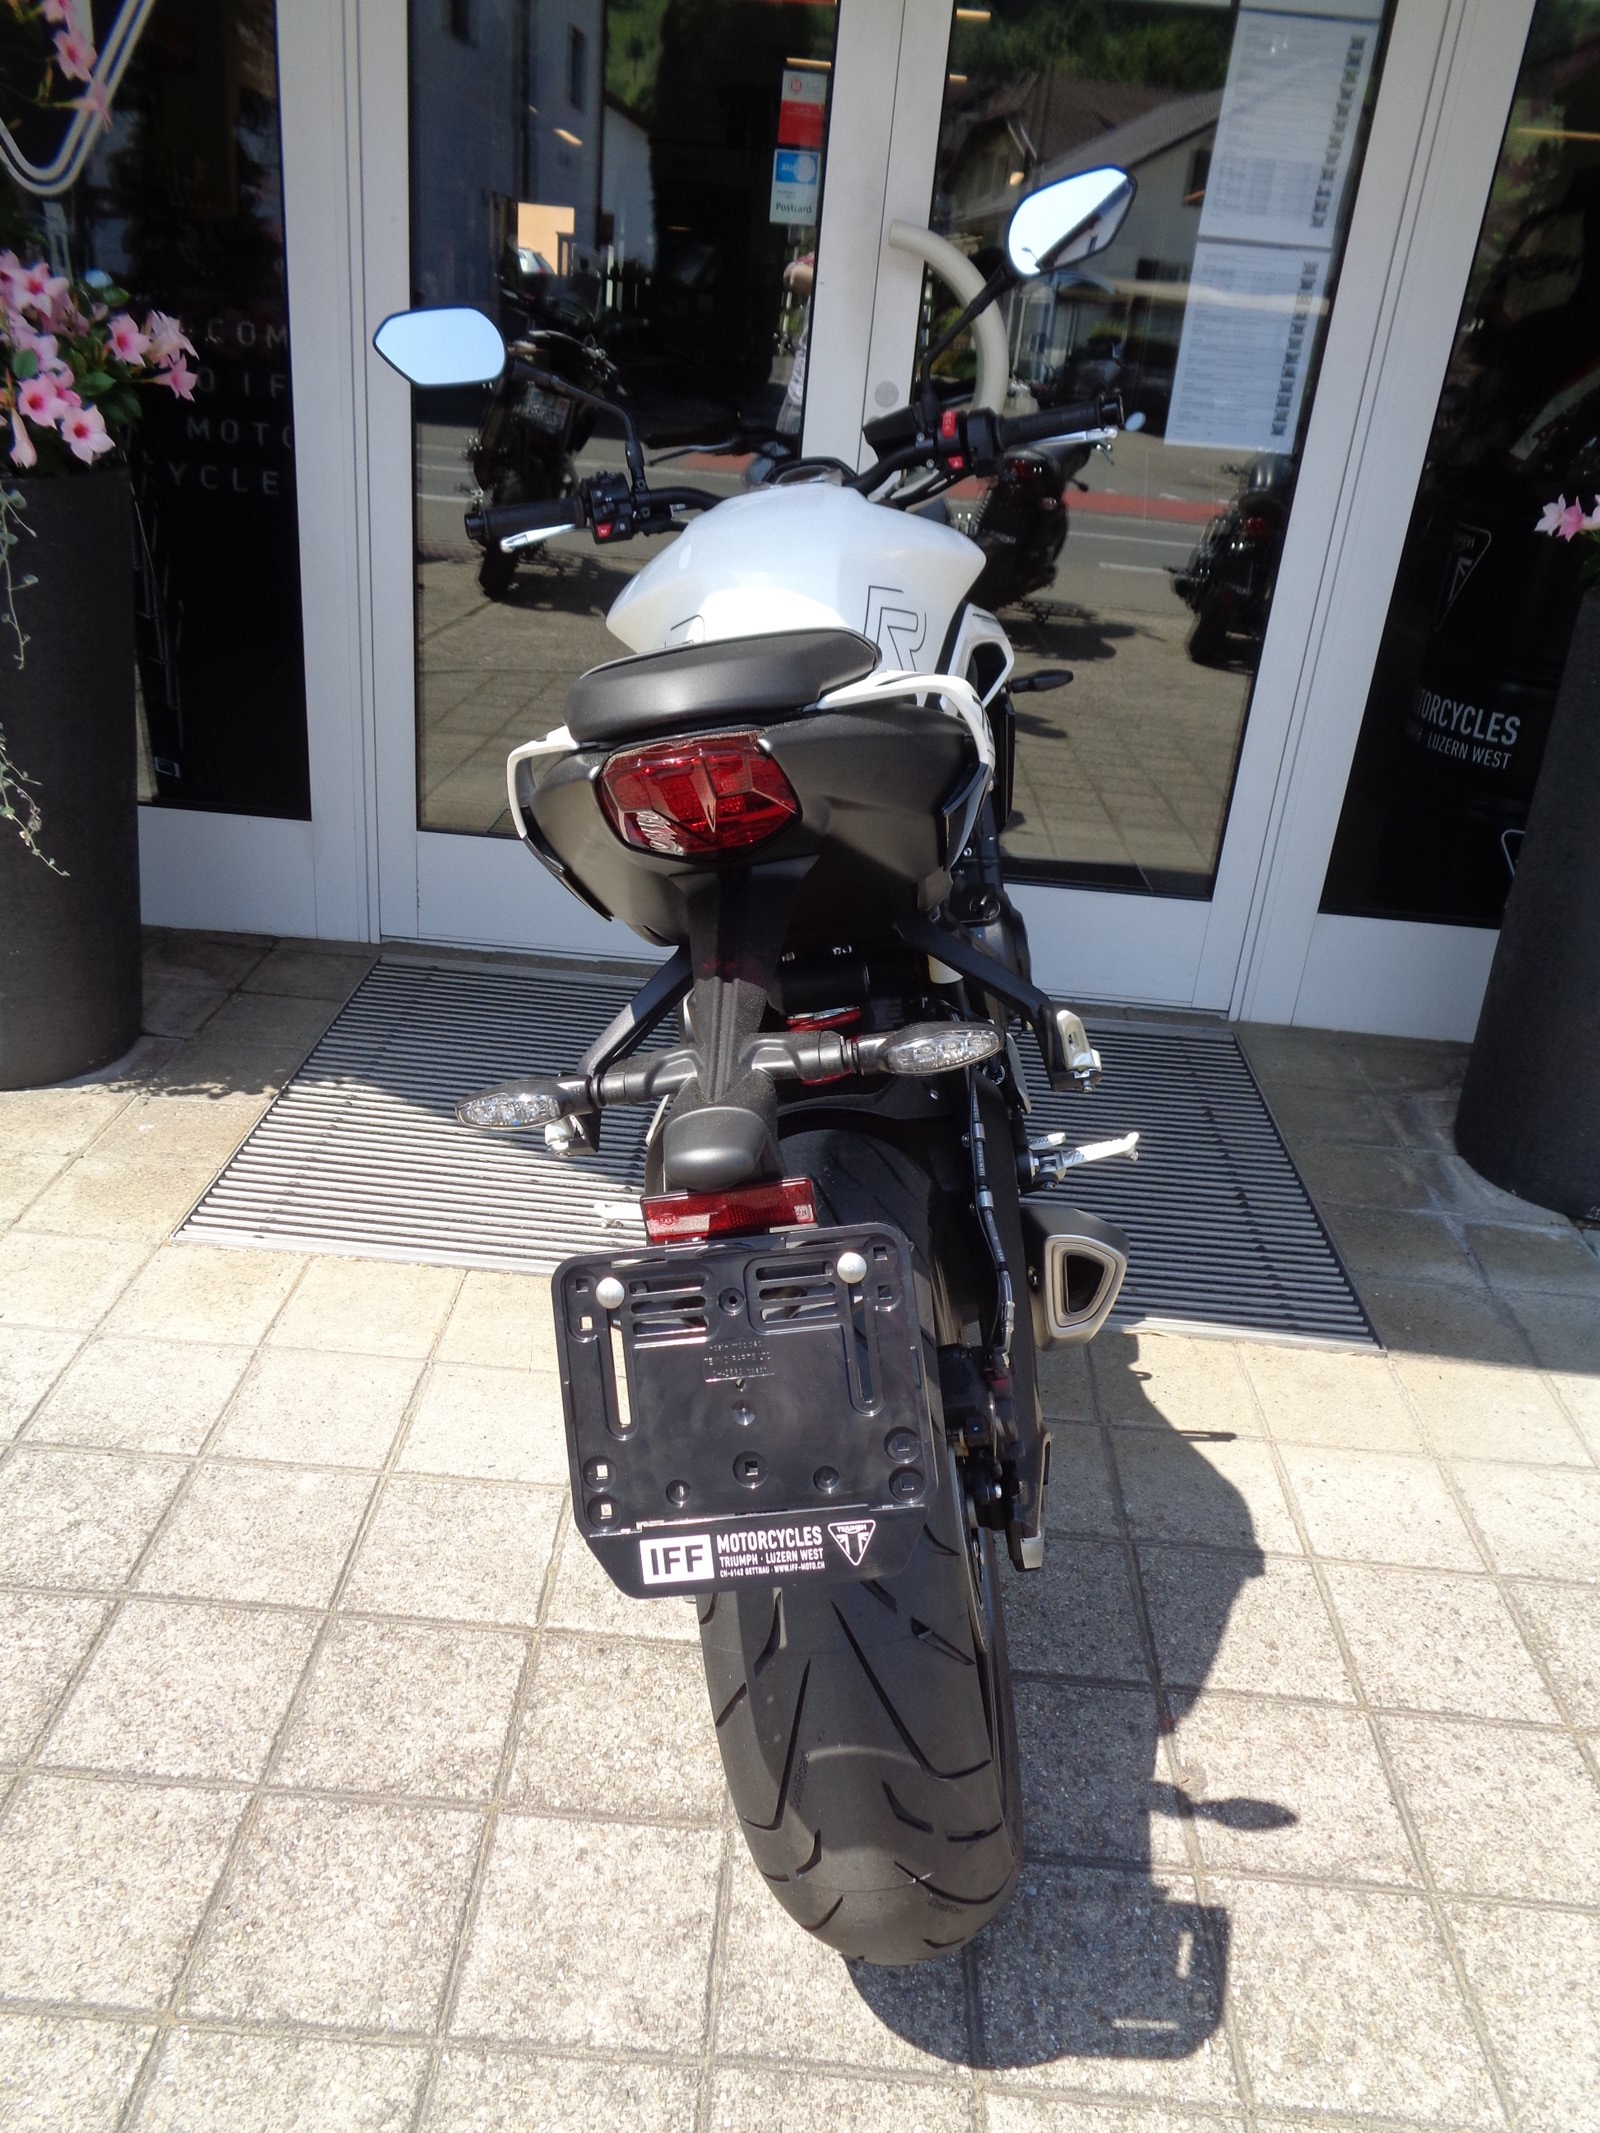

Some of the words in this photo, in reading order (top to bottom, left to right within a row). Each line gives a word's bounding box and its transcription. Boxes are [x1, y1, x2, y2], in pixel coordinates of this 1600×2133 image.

[775, 202, 812, 213] Postcard
[1427, 731, 1469, 760] LUZERN
[1472, 745, 1513, 770] WEST
[716, 1525, 823, 1554] MOTORCYCLES
[650, 1544, 704, 1576] IFF
[719, 1553, 758, 1568] TRIUMPH
[765, 1549, 798, 1564] LUZERN
[799, 1547, 824, 1561] WEST
[774, 1560, 825, 1574] WWW.IFF-MOTO.CH
